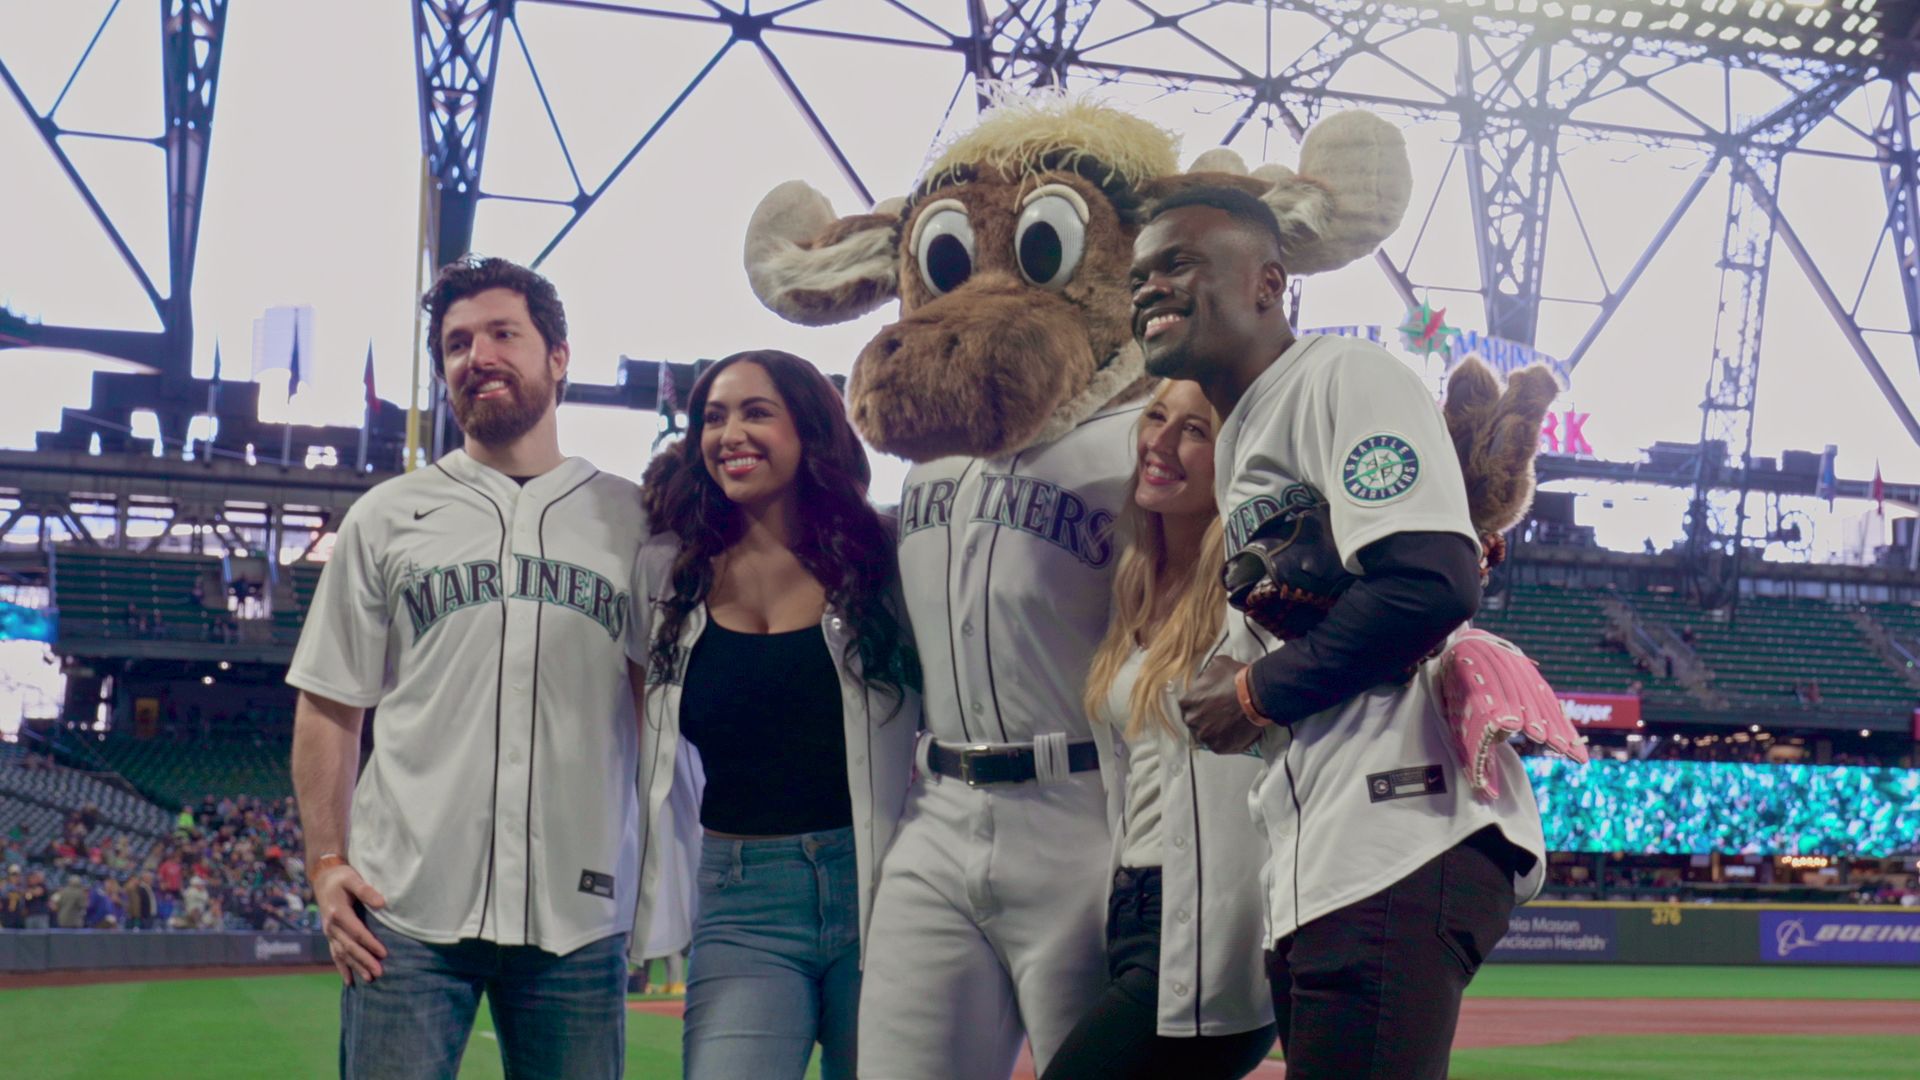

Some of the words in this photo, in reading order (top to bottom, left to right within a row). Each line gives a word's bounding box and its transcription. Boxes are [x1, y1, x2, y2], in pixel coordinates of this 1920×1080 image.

[1540, 411, 1594, 454] RK
[1345, 437, 1410, 471] SEATTLE
[1349, 466, 1417, 499] MARINERS
[899, 472, 1119, 570] ARINERS
[401, 554, 630, 642] MARINERS
[1508, 915, 1530, 932] nia
[1532, 917, 1581, 933] Mason
[1651, 908, 1681, 926] 376
[1495, 932, 1553, 950] nciscan
[1554, 934, 1606, 951] Health
